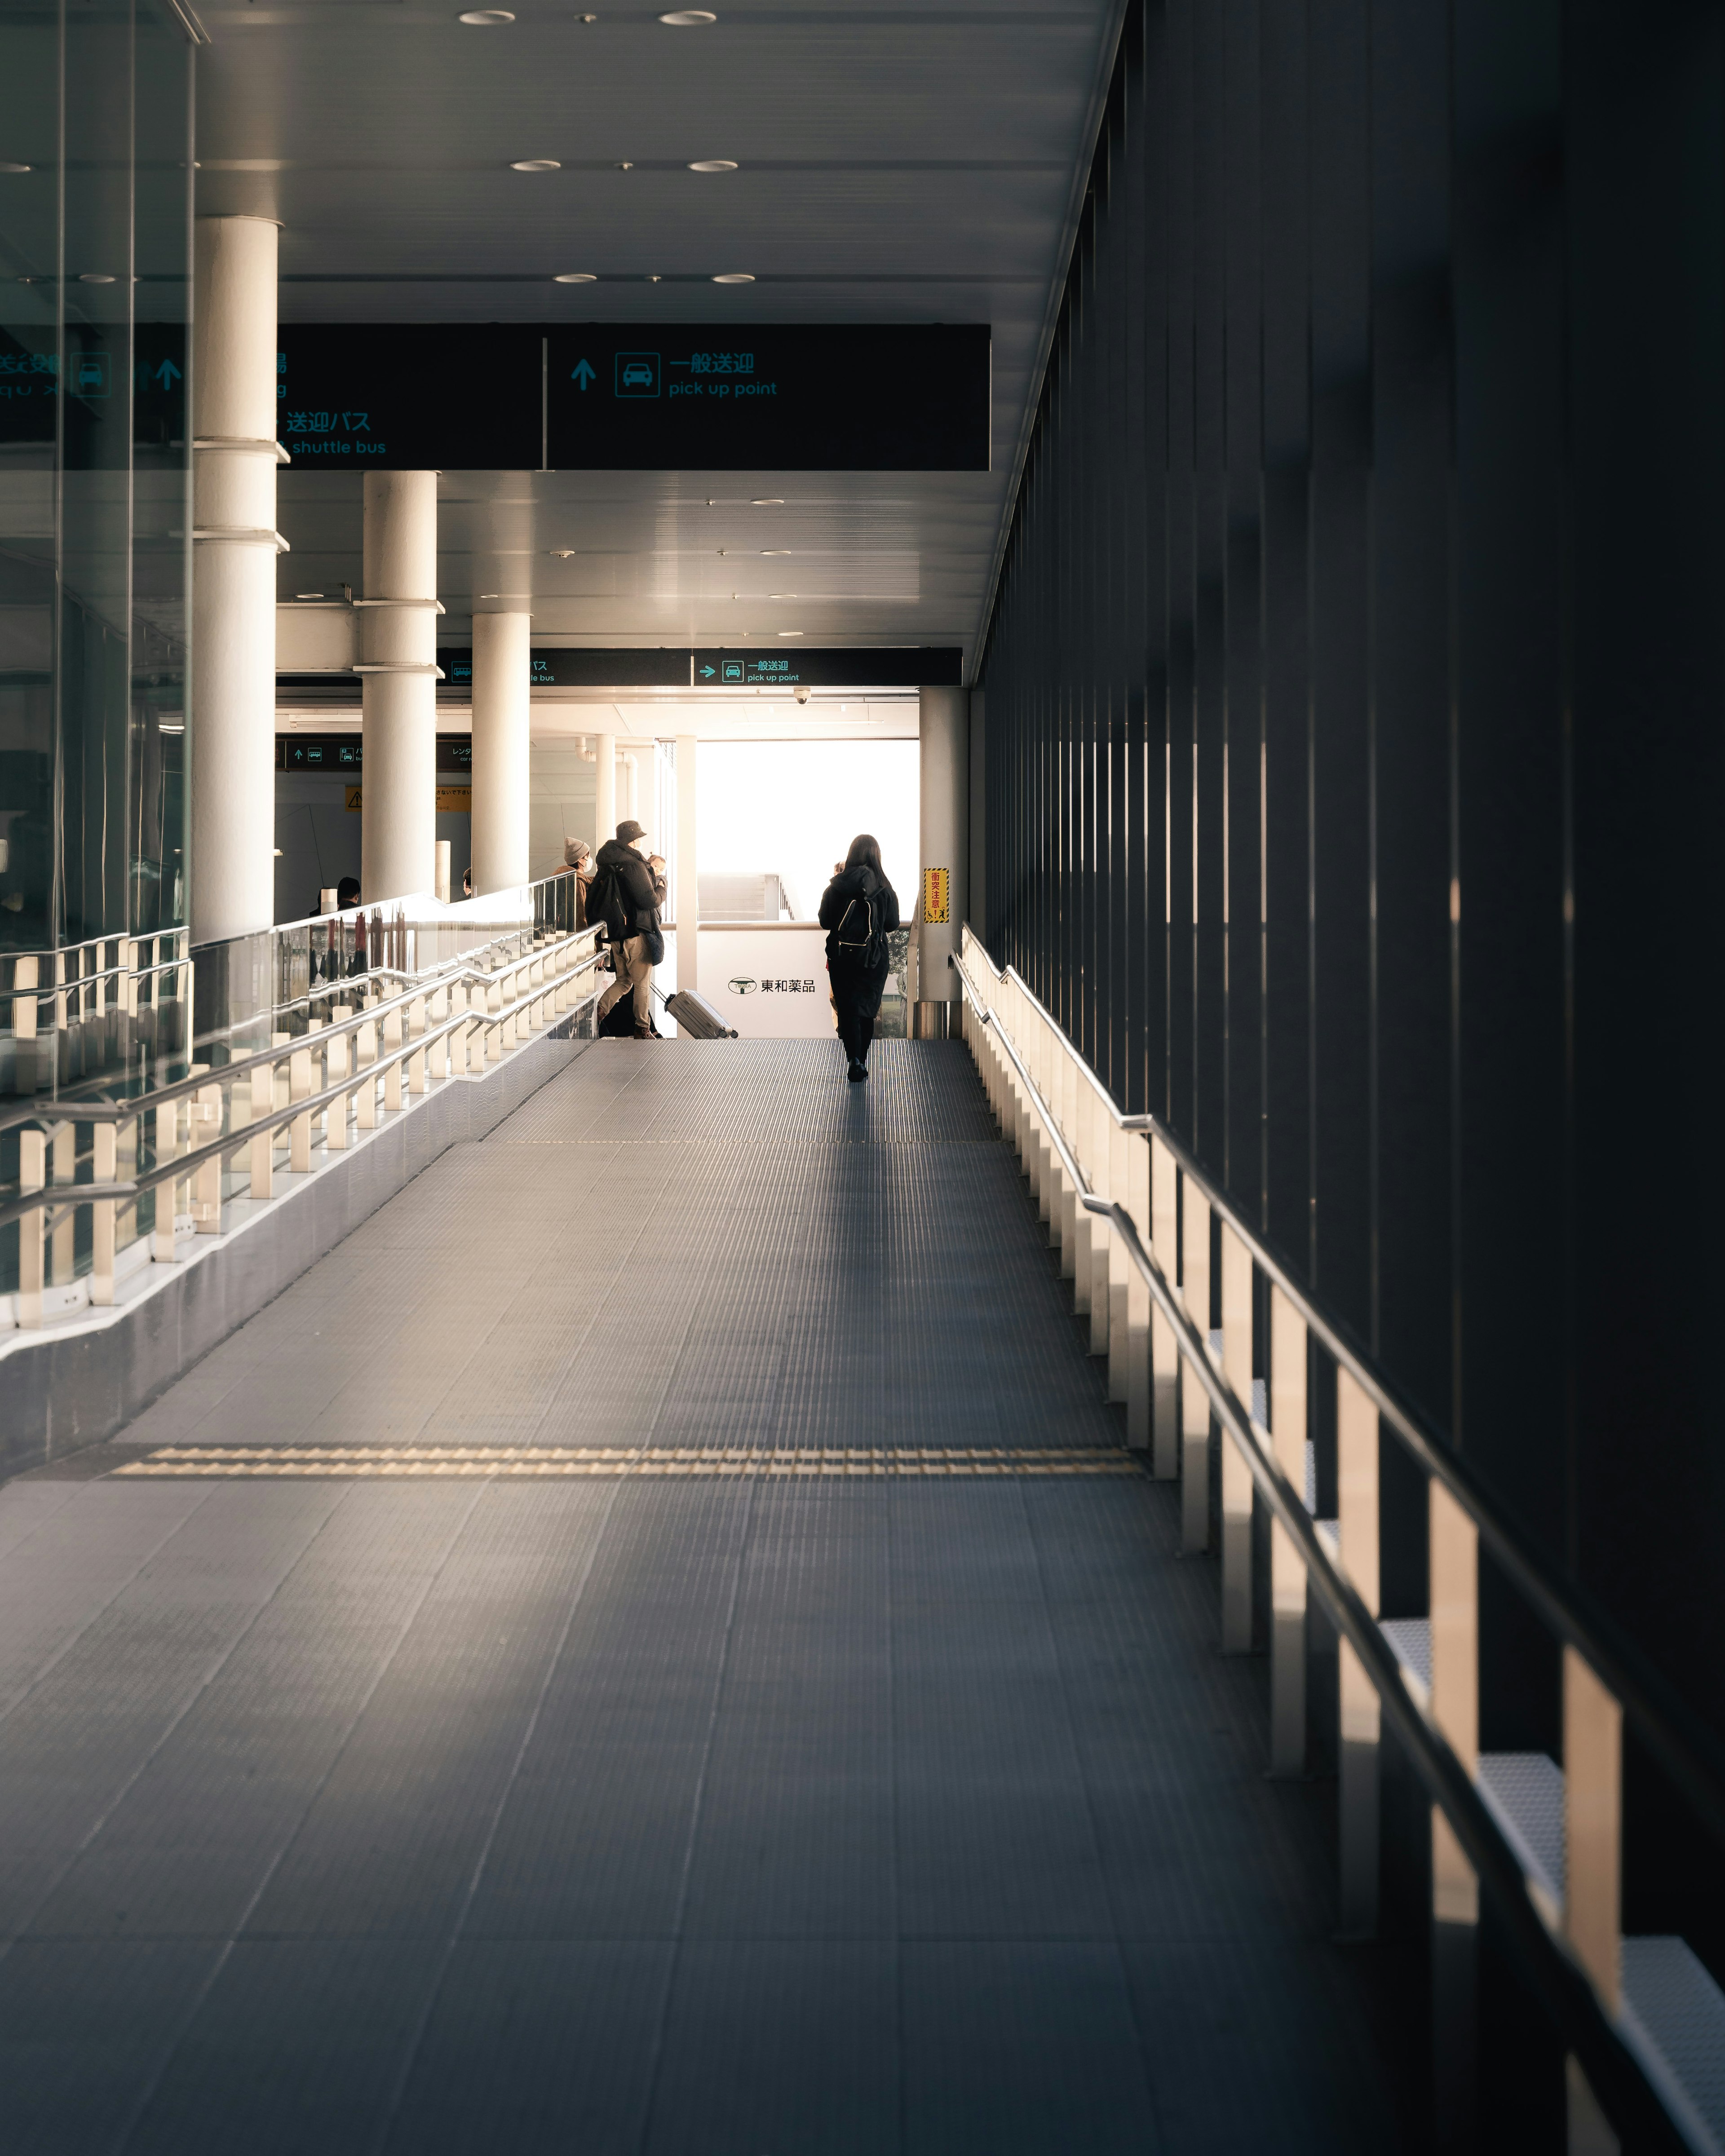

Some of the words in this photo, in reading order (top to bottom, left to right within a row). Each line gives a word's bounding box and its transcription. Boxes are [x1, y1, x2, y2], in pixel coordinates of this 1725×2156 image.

[669, 352, 754, 374] 一般送迎
[669, 381, 703, 398] pick
[708, 384, 730, 398] up
[734, 381, 777, 398] point
[292, 440, 351, 454] shuttle
[356, 440, 386, 454] bus
[748, 660, 788, 671] 一般送迎
[748, 674, 765, 682] pick
[778, 674, 799, 682] point
[761, 980, 815, 993] 東和薬品
